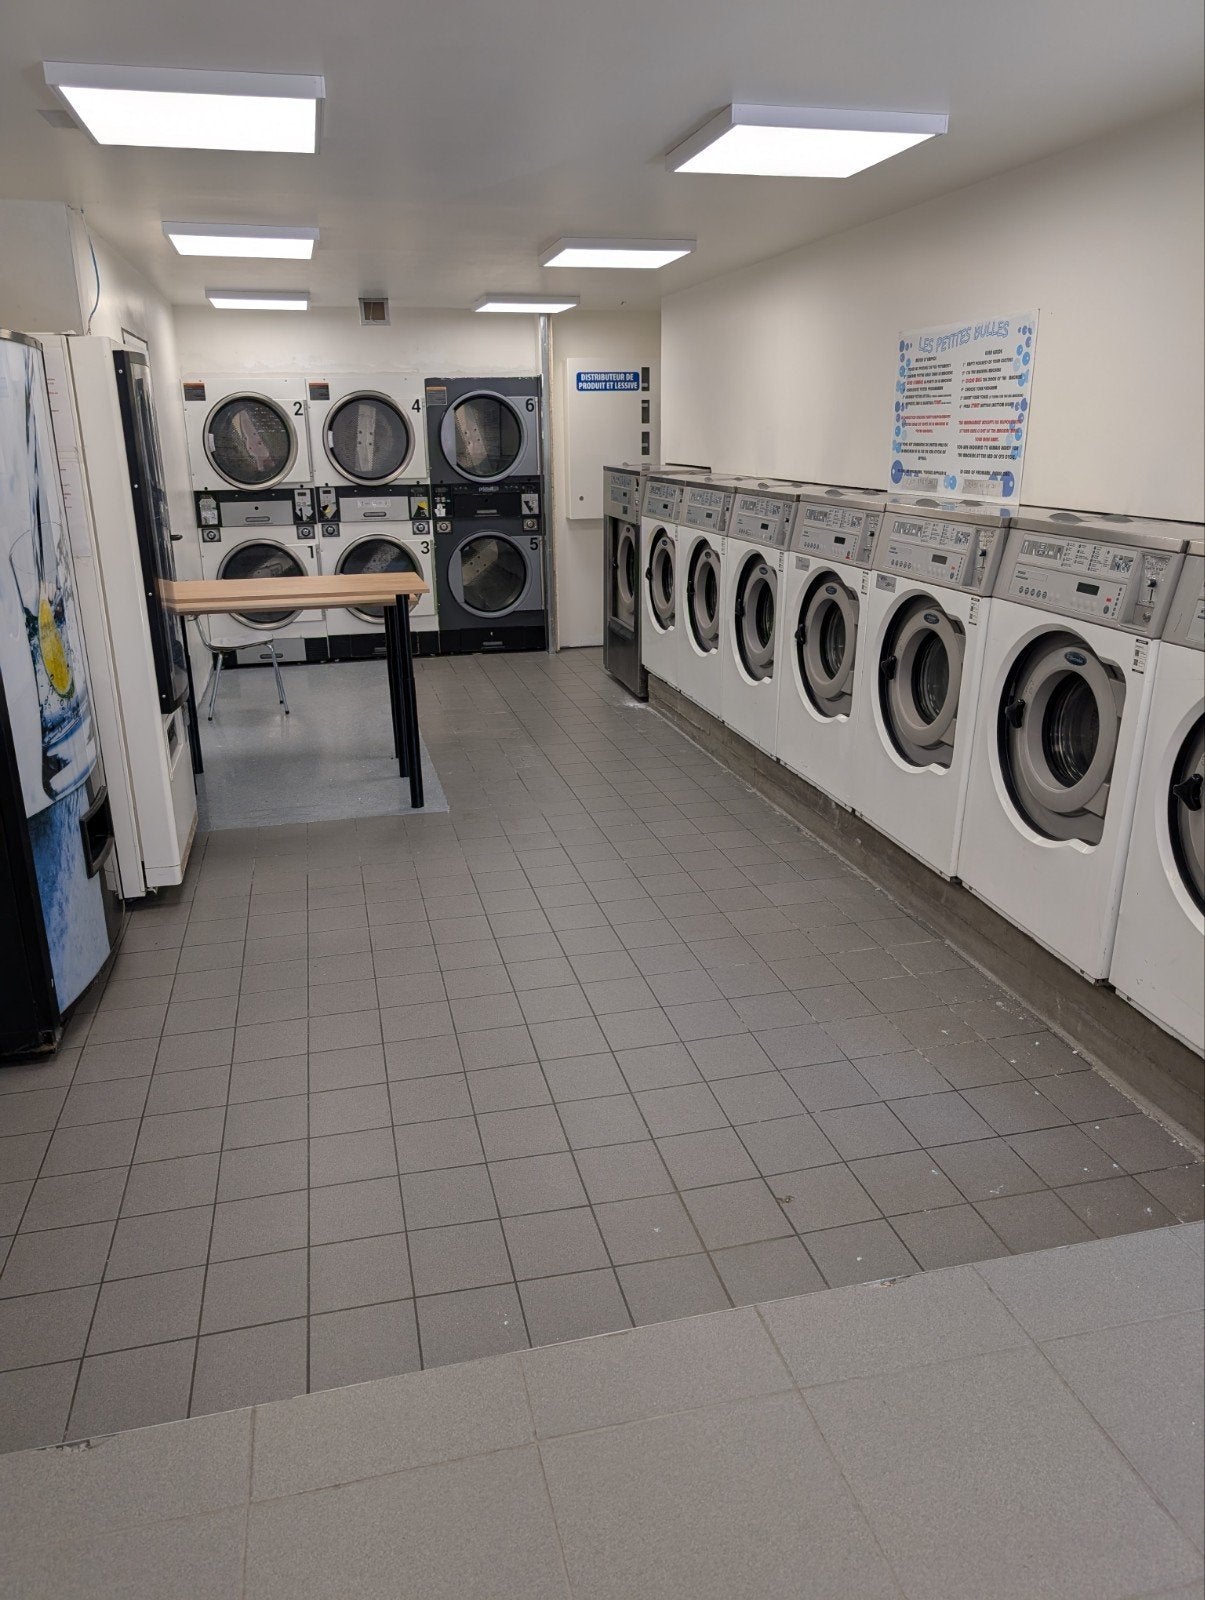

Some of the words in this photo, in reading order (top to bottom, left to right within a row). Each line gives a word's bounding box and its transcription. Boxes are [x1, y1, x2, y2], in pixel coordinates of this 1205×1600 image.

[918, 336, 934, 353] LES
[935, 326, 972, 353] PETITES
[973, 320, 1009, 341] BULLES
[580, 373, 625, 381] DISTRIBUTEUR
[626, 373, 634, 381] DE
[578, 381, 605, 389] PRODUIT
[606, 381, 613, 389] ET
[614, 381, 638, 389] LESSIVE
[293, 402, 303, 416] 2
[411, 399, 421, 413] 4
[525, 398, 535, 412] 6
[420, 541, 430, 554] 3
[530, 537, 538, 550] 5
[307, 545, 314, 558] 1
